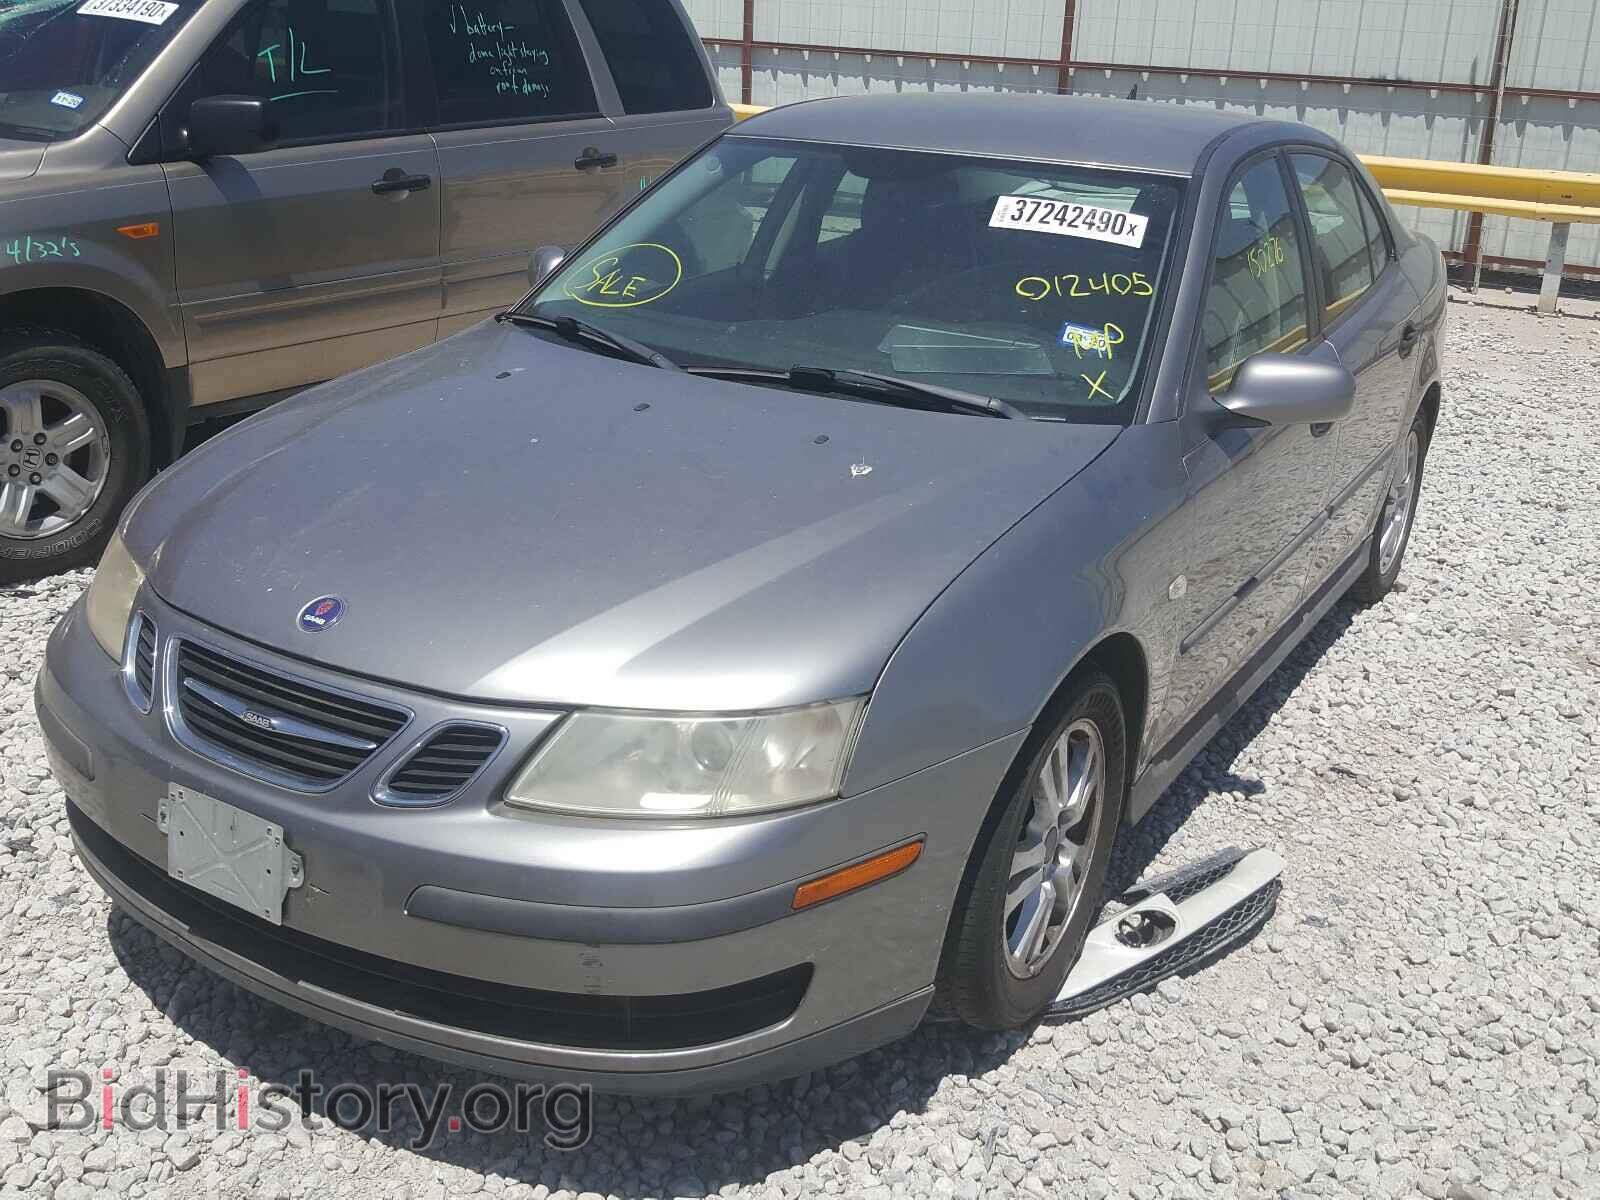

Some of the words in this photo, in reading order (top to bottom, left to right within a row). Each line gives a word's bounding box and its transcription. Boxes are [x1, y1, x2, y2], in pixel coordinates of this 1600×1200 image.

[1015, 271, 1154, 301] 012405
[303, 614, 326, 625] SAAB
[246, 712, 271, 727] SAAB
